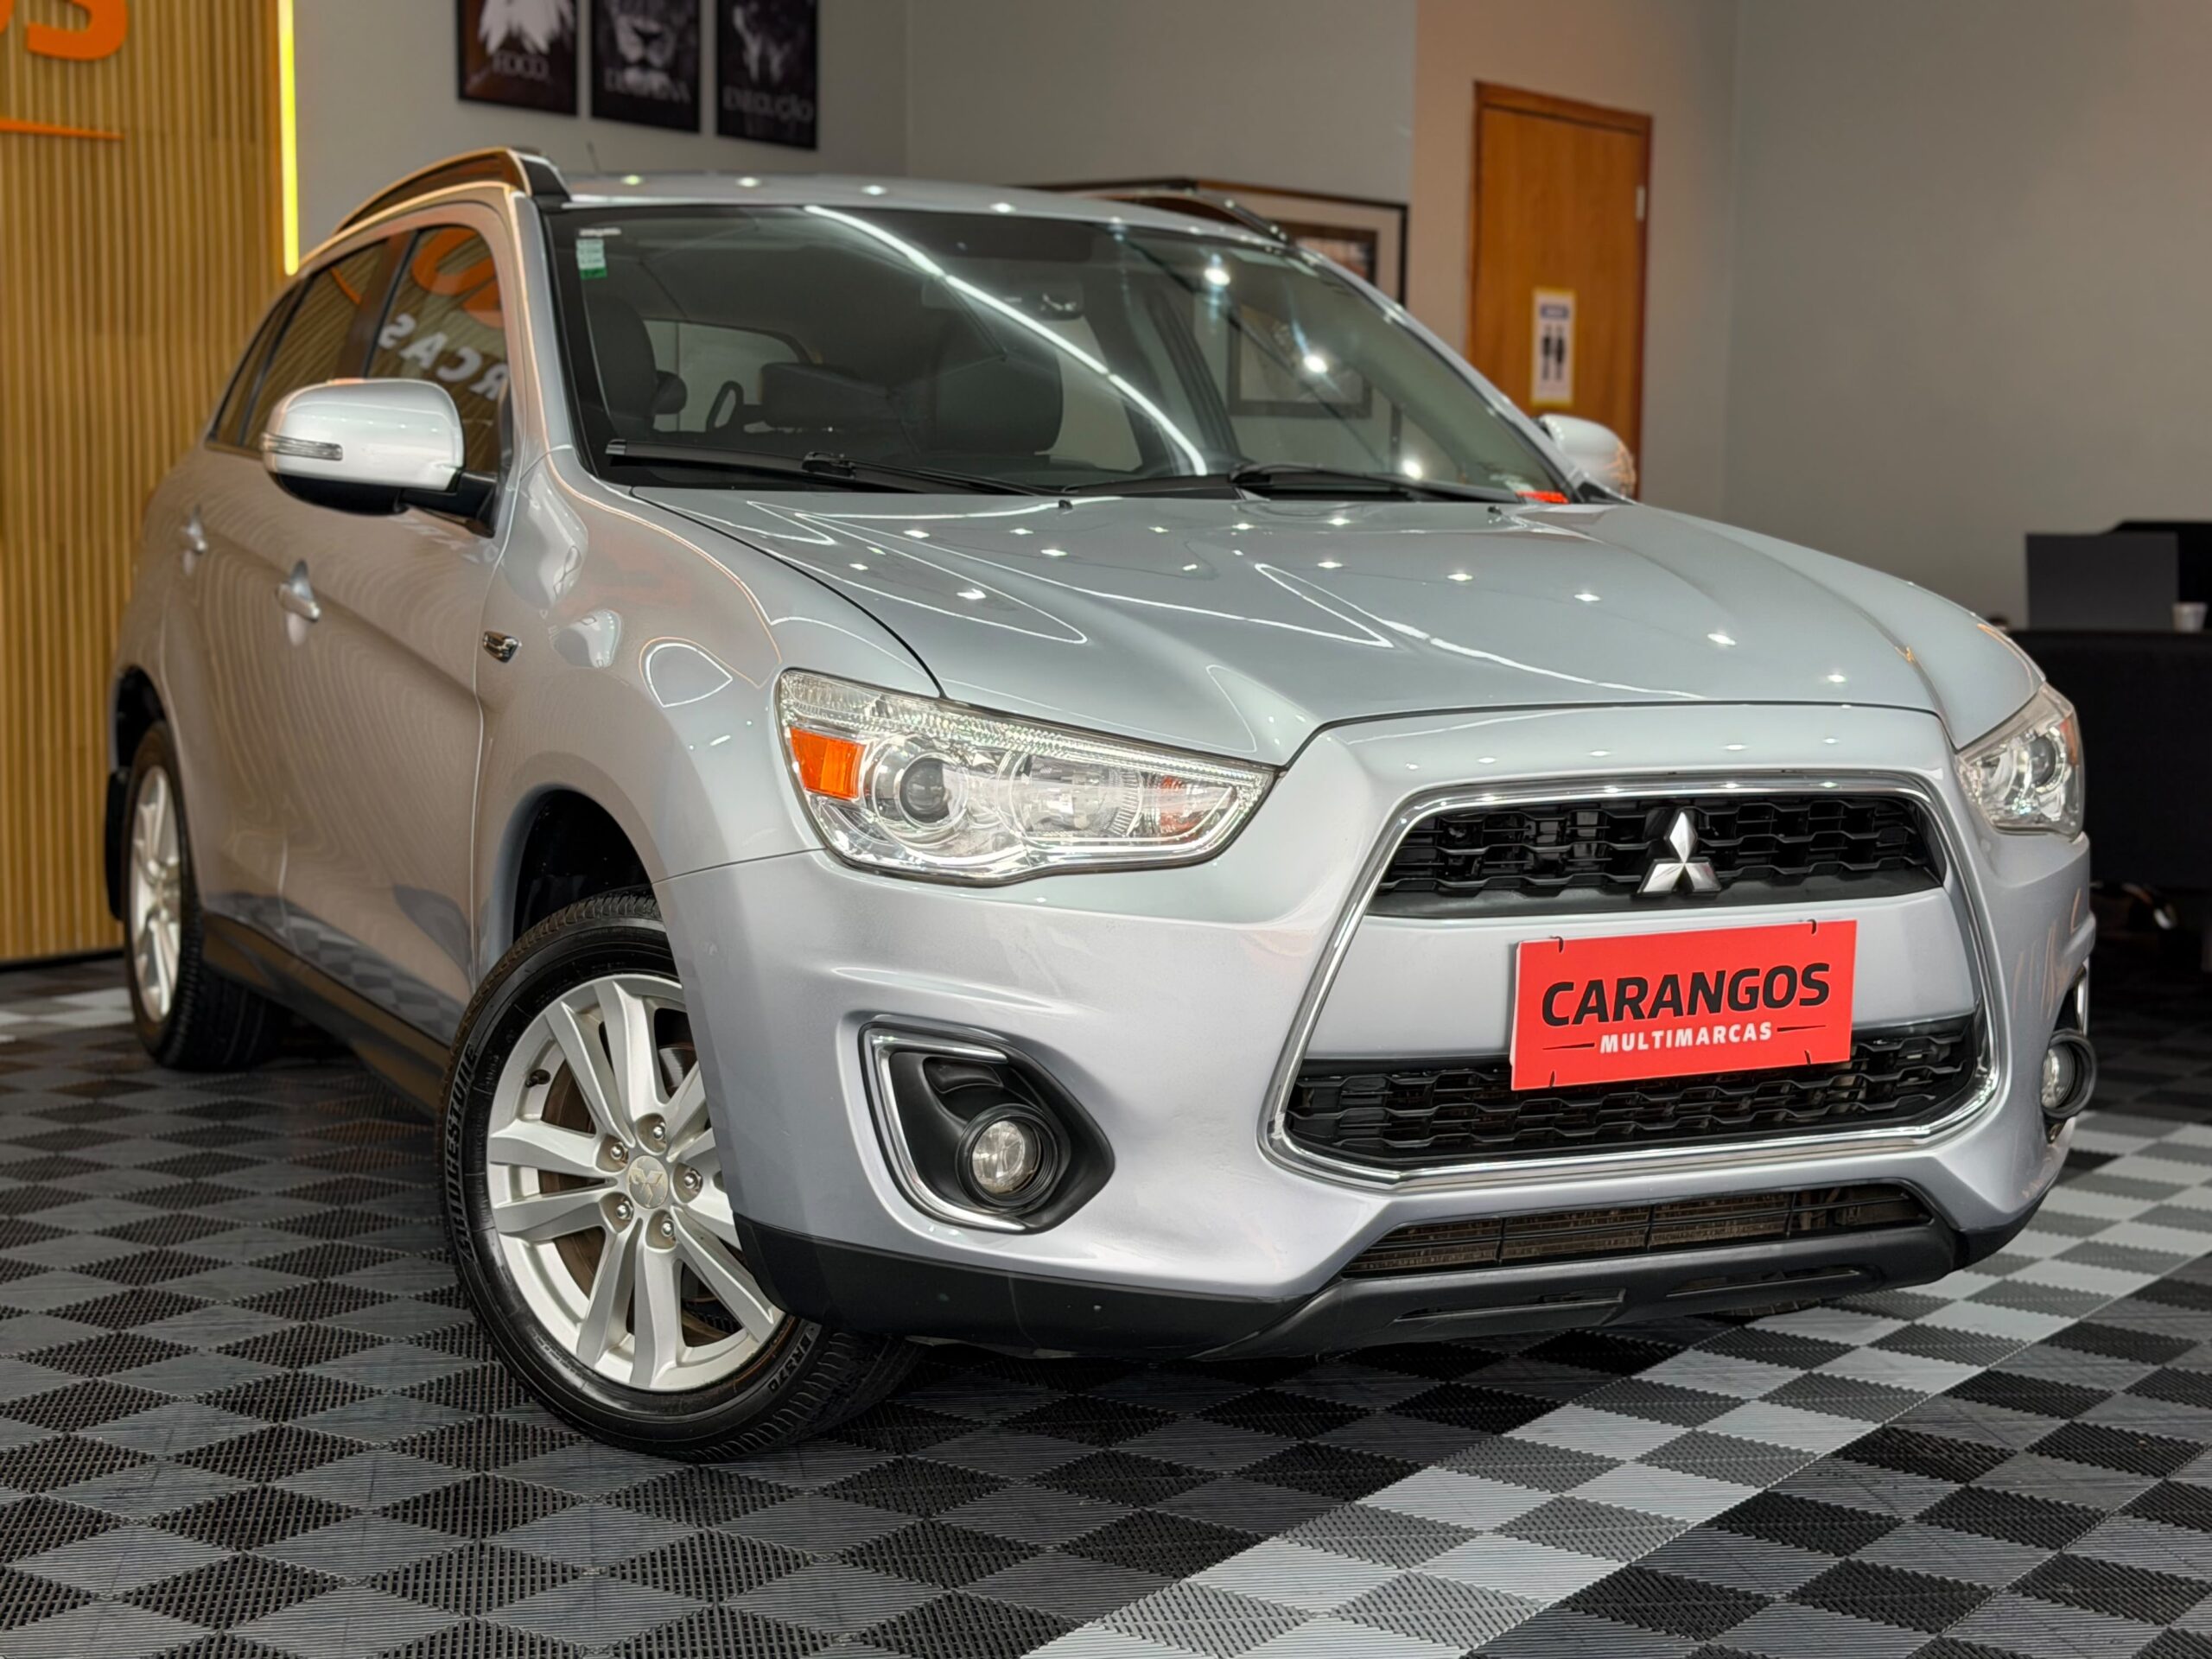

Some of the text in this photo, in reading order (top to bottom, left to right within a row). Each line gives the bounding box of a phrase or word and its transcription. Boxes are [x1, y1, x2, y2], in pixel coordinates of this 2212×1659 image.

[1541, 962, 1830, 1027] CARANGOS
[1600, 1022, 1772, 1053] MULTIMARCAS
[446, 1042, 479, 1262] BRIDGESTONE
